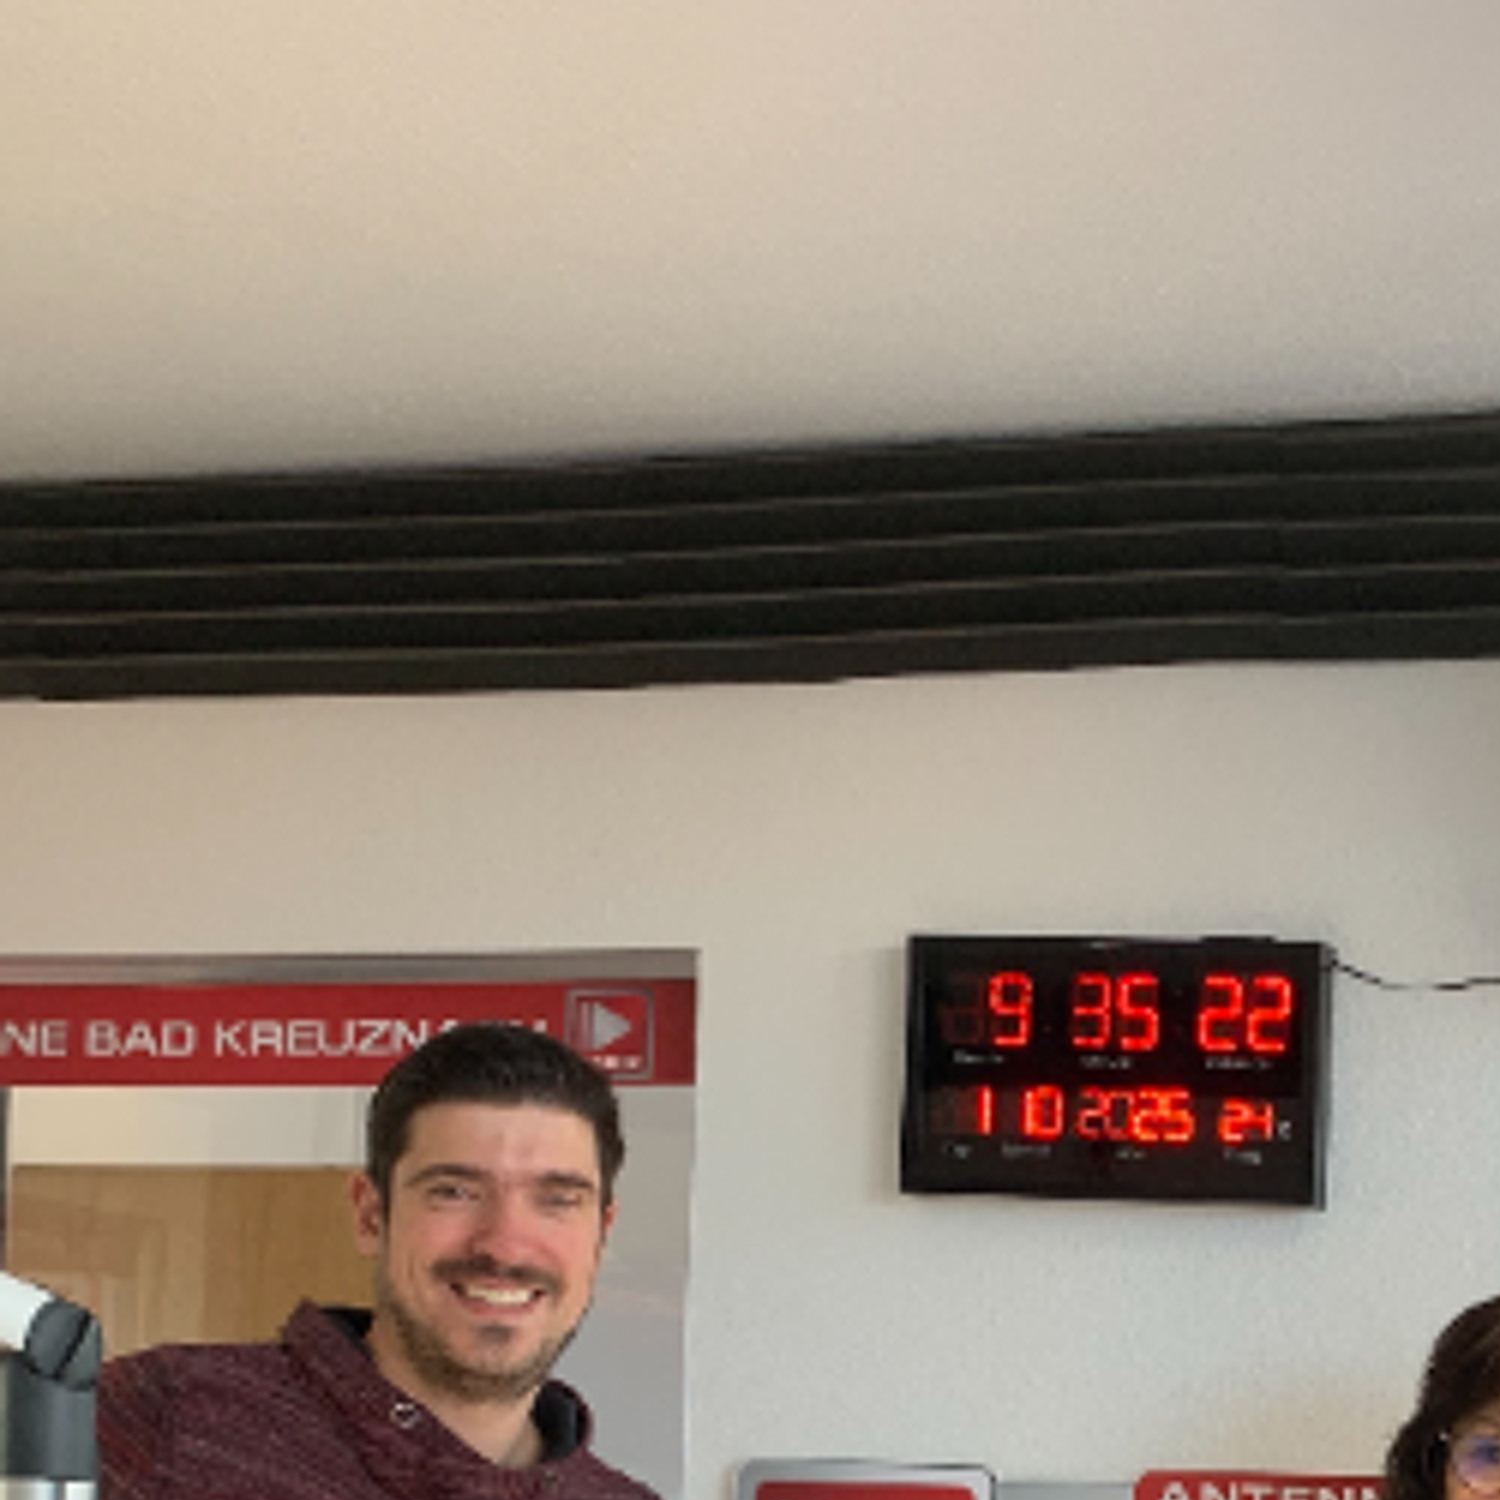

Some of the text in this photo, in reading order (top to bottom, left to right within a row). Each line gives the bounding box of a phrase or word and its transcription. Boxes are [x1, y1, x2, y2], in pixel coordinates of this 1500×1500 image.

[86, 1018, 195, 1057] BAD
[214, 1018, 547, 1057] KREUZN
[988, 972, 1292, 1053] 9 35 22
